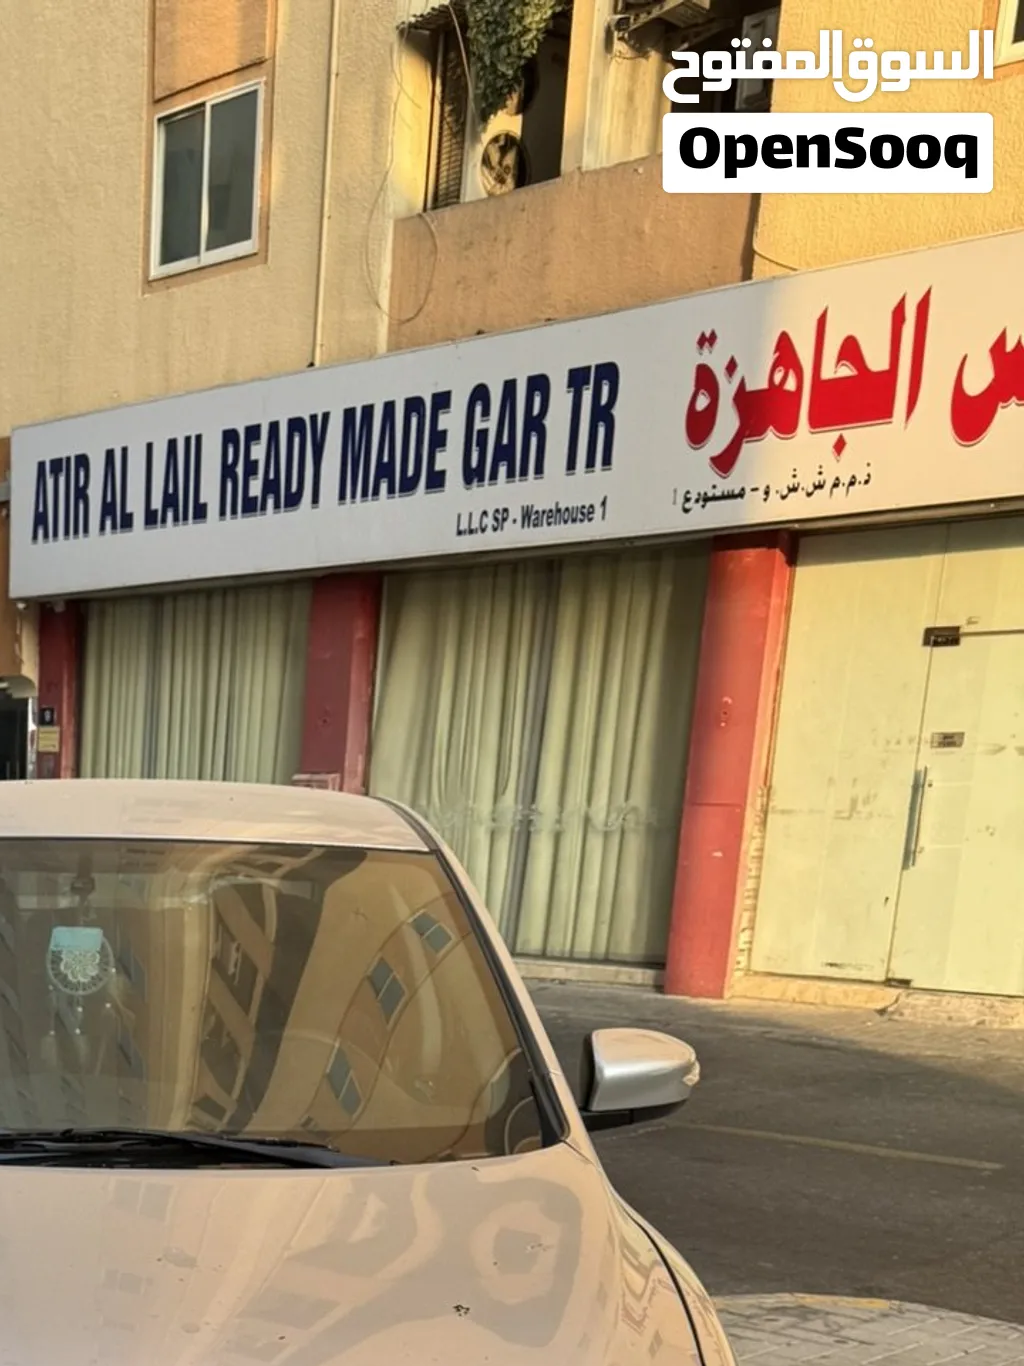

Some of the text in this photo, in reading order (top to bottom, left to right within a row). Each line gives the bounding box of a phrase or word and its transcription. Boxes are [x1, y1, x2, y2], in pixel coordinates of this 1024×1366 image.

[31, 361, 620, 544] ATIR AL LAIL READY MADE GAR TR
[685, 285, 932, 479] الجاهزة
[492, 508, 509, 532] SP
[520, 501, 595, 529] Warehouse
[600, 495, 607, 521] 1
